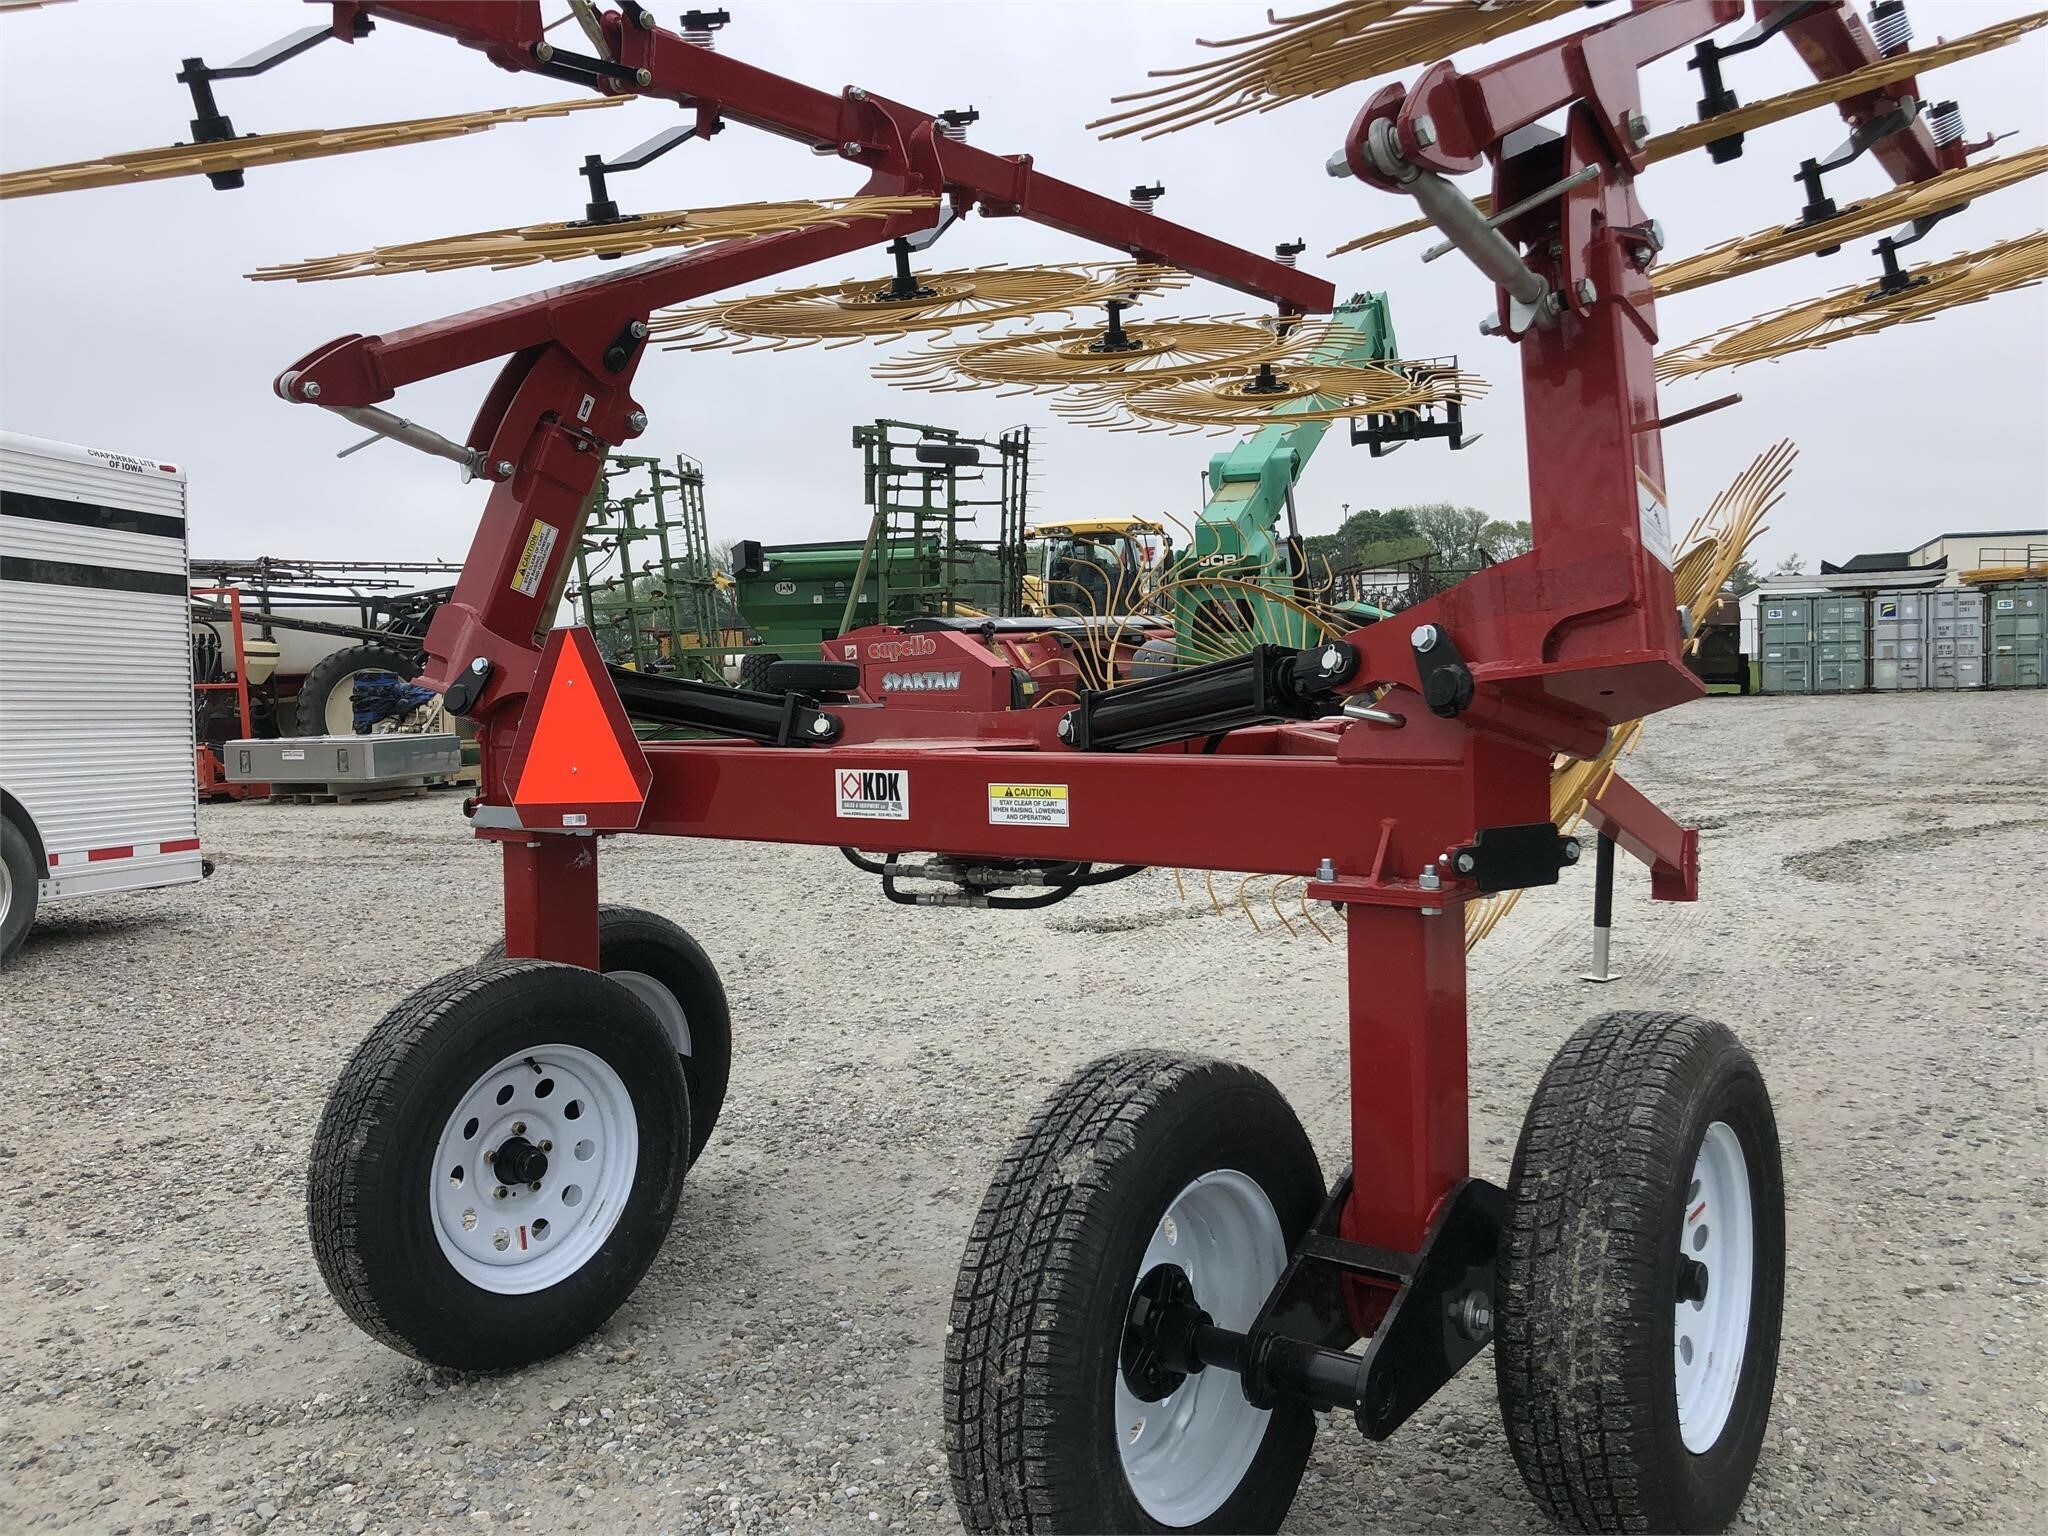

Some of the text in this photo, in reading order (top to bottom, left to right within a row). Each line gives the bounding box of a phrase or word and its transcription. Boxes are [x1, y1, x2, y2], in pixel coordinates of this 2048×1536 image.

[87, 449, 157, 469] CHAPARRAL LITE
[109, 460, 144, 474] OF IOWA
[522, 534, 538, 568] CAUTION
[1198, 554, 1238, 568] JCB
[867, 635, 937, 662] capello
[881, 671, 962, 692] SPARTAN
[862, 772, 901, 801] KDK
[1014, 788, 1052, 797] CAUTION
